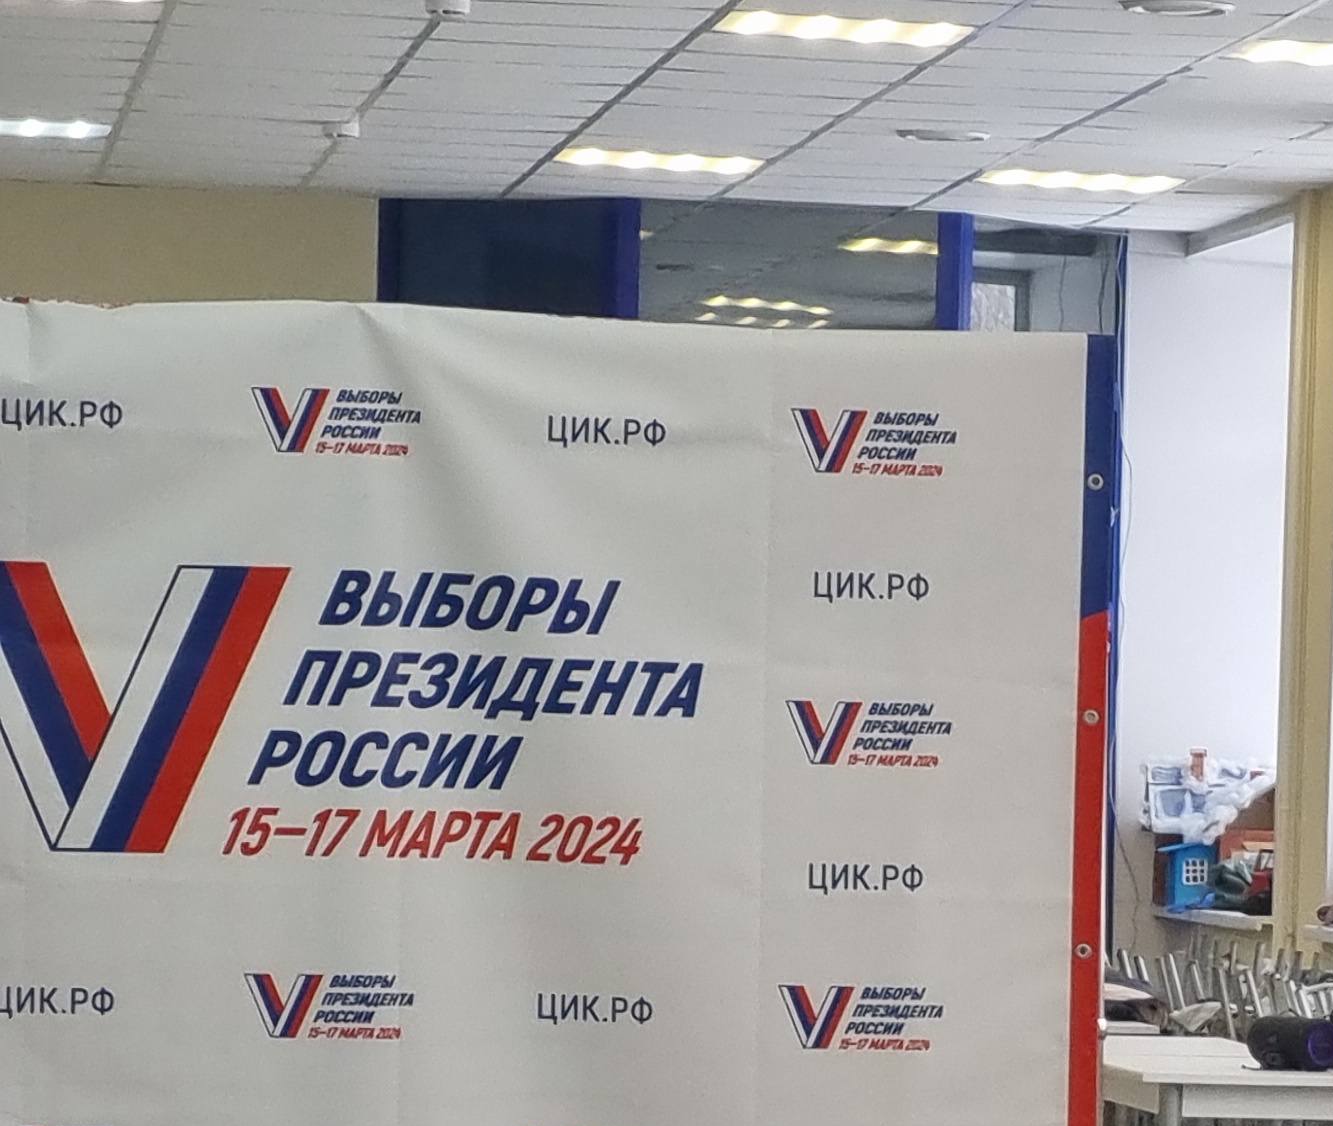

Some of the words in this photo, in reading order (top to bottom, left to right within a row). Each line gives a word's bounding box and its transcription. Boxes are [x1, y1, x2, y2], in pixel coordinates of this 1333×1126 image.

[336, 390, 402, 404] ВЫБОРЫ
[2, 399, 123, 431] ЦИК.РФ
[328, 407, 420, 424] ПРЕЗИДЕНТА
[873, 411, 939, 426] ВЫБОРЫ
[320, 425, 381, 439] РОССИИ
[547, 414, 667, 448] ЦИК.РФ
[865, 429, 957, 445] ПРЕЗИДЕНТА
[345, 443, 381, 455] МАРТА
[857, 447, 917, 460] РОССИИ
[881, 464, 916, 475] МАРТА
[813, 571, 930, 602] ЦИК.РФ
[318, 569, 621, 635] ВЫБОРЫ
[282, 648, 703, 721] ПРЕЗИДЕНТА
[868, 702, 933, 716] ВЫБОРЫ
[860, 720, 952, 735] ПРЕЗИДЕНТА
[852, 738, 913, 751] РОССИИ
[247, 729, 524, 790] РОССИИ
[877, 755, 912, 766] МАРТА
[359, 808, 522, 860] МАРТА
[525, 813, 643, 866] 2024
[808, 862, 924, 895] ЦИК.РФ
[329, 975, 396, 988] ВЫБОРЫ
[321, 993, 415, 1007] ПРЕЗИДЕНТА
[861, 987, 926, 1000] ВЫБОРЫ
[0, 986, 114, 1018] ЦИК.РФ
[313, 1010, 375, 1023] РОССИИ
[537, 993, 654, 1026] ЦИК.РФ
[852, 1005, 943, 1019] ПРЕЗИДЕНТА
[338, 1028, 374, 1039] МАРТА
[845, 1022, 905, 1035] РОССИИ
[869, 1039, 903, 1050] МАРТА
